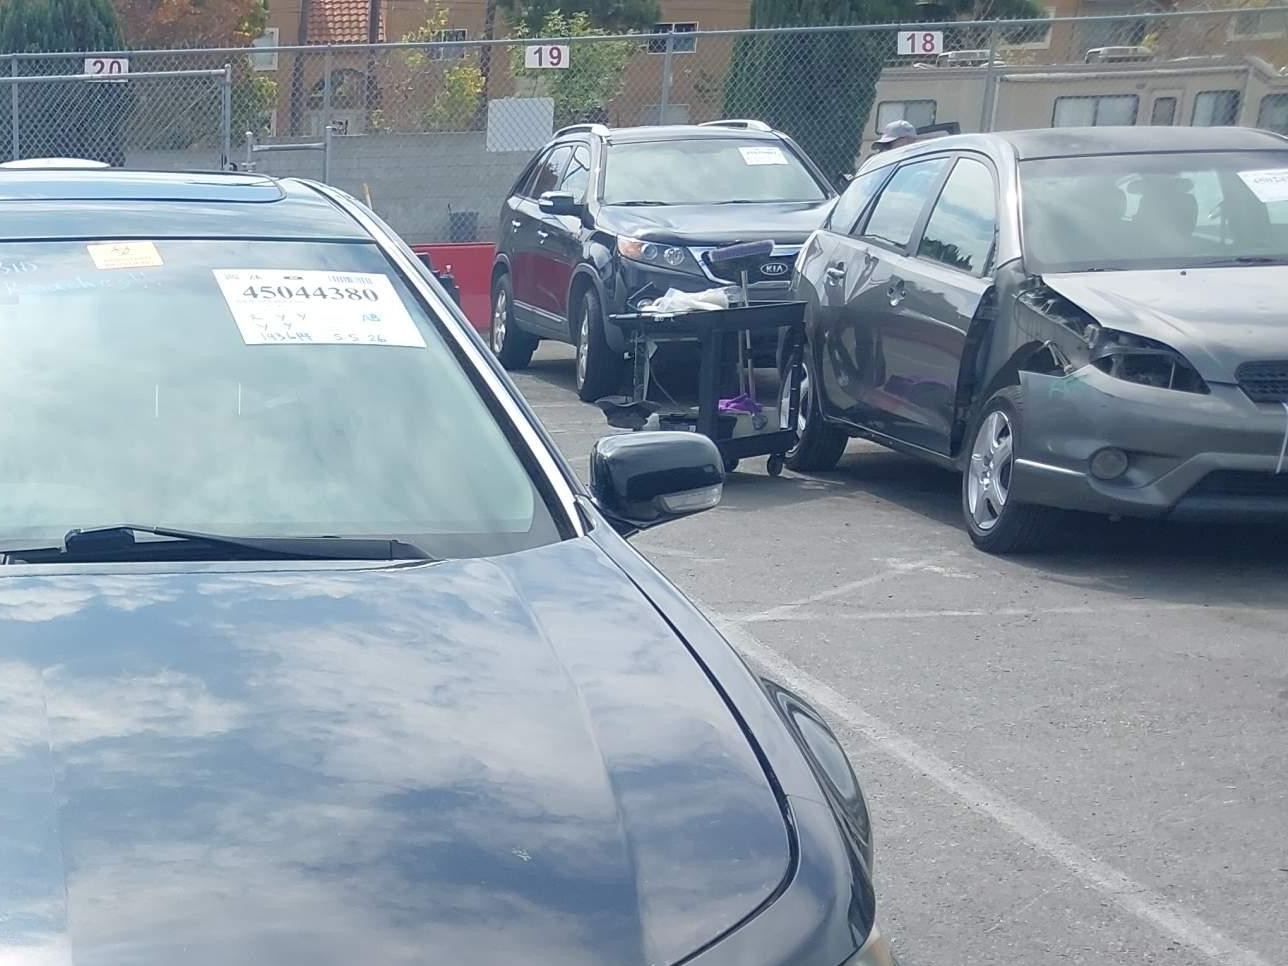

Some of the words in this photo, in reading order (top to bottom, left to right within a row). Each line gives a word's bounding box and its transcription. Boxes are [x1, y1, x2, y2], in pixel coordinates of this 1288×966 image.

[906, 33, 935, 53] 18
[534, 46, 562, 67] 19
[93, 60, 122, 76] 20
[766, 265, 783, 273] KIA
[243, 286, 379, 302] 45044380
